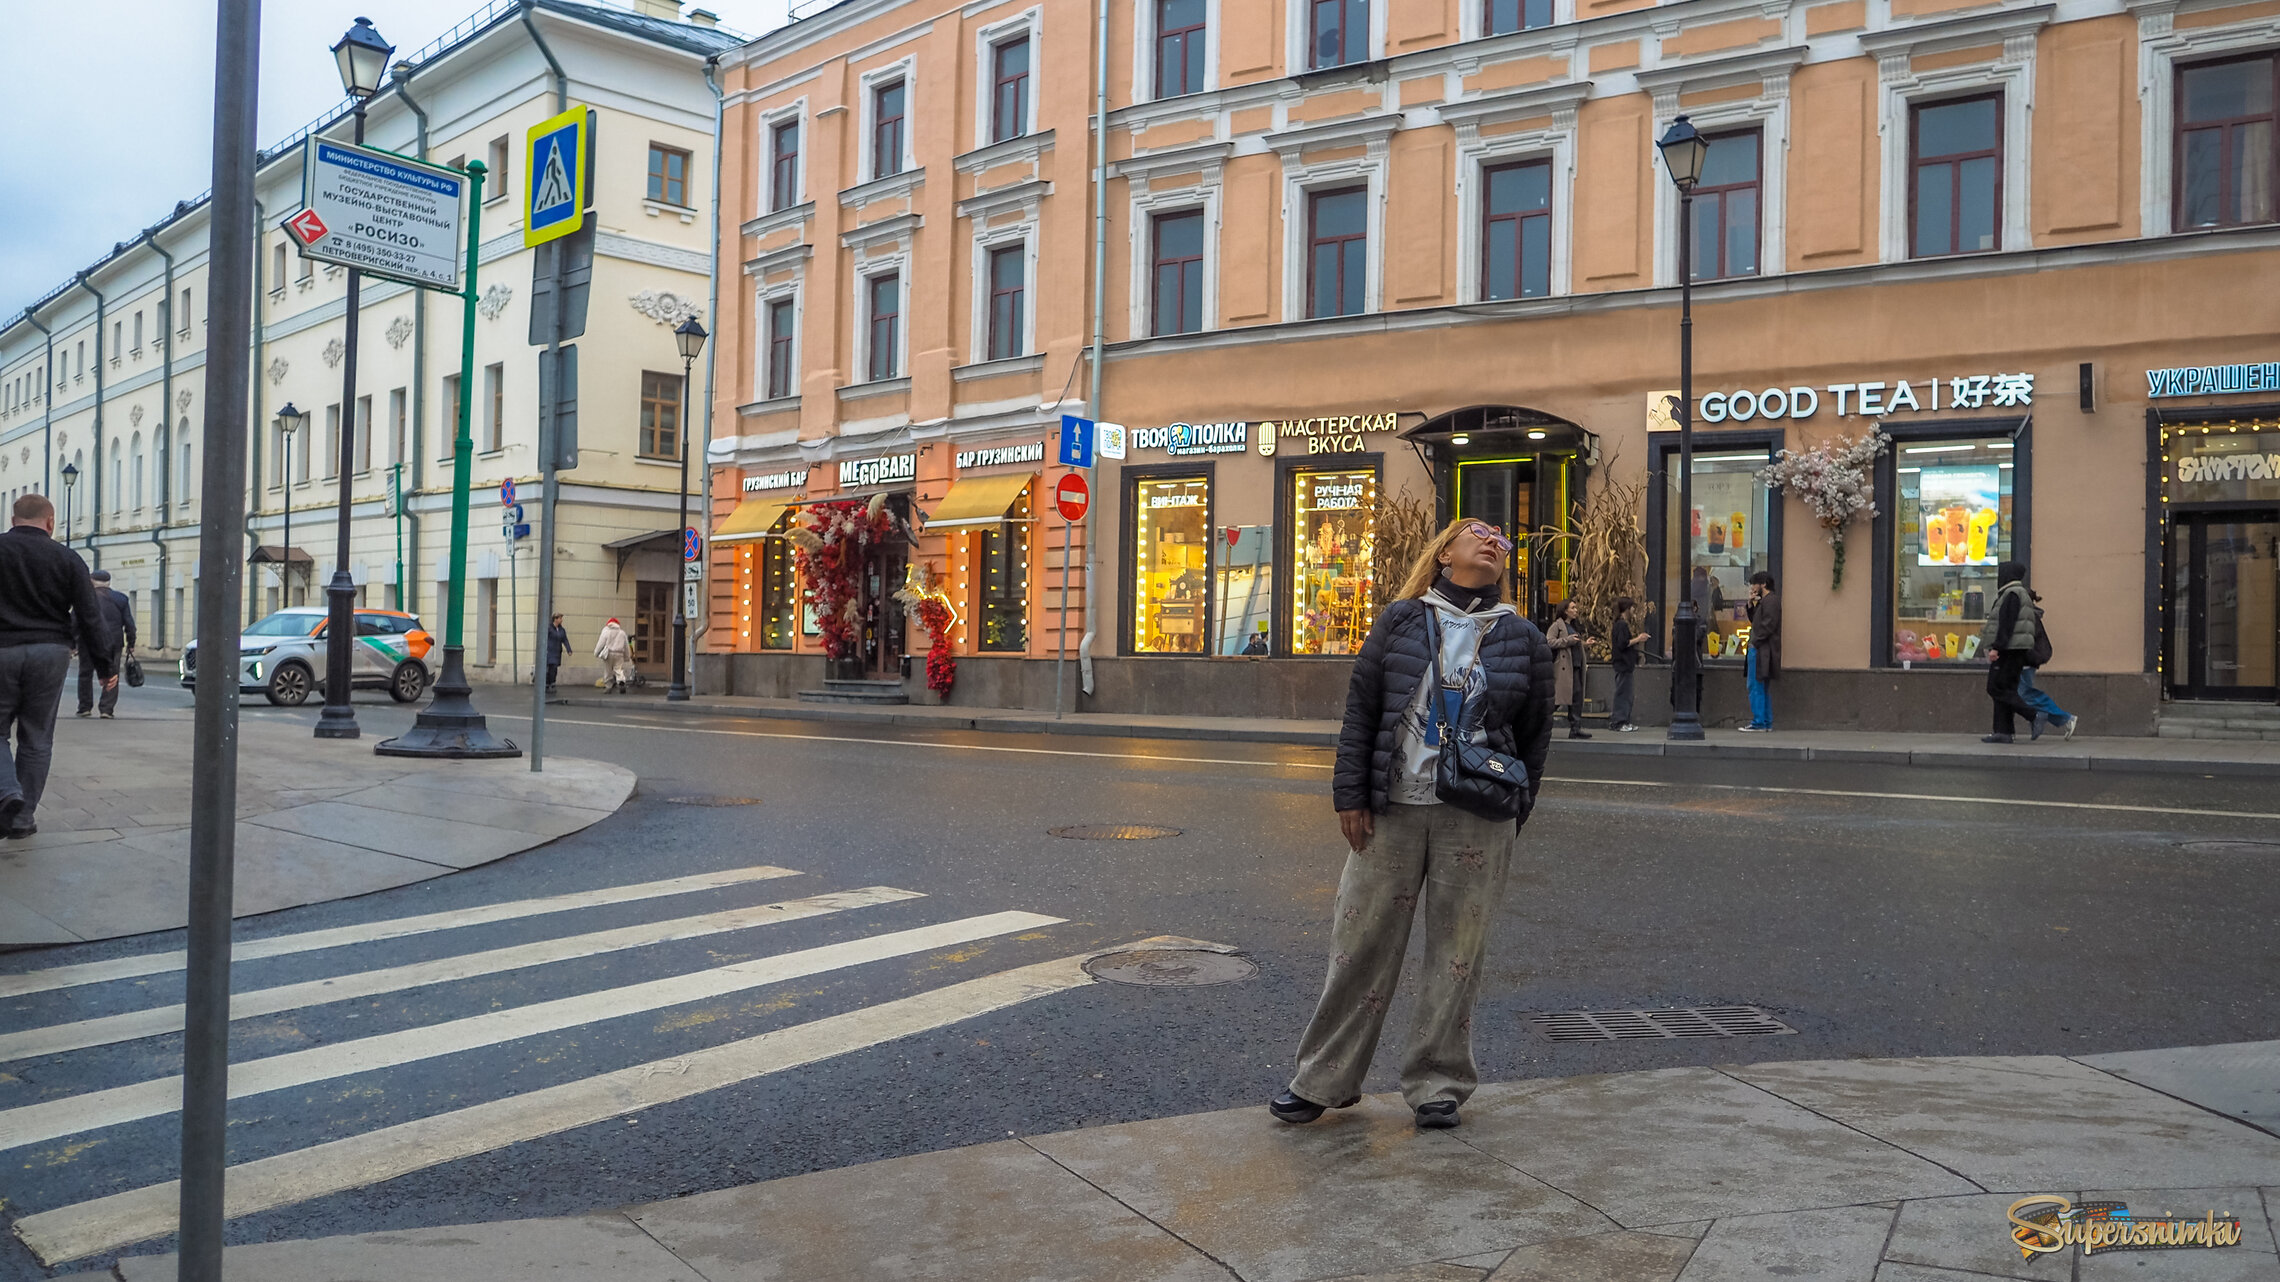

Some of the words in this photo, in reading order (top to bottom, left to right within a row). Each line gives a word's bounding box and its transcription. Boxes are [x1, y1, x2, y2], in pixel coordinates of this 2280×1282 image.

[326, 151, 396, 177] МИНИСТЕРСТВО
[397, 170, 439, 189] КУЛЬТУРЫ
[440, 183, 453, 192] РФ
[322, 191, 450, 230] МУЗЕЙНО-ВЫСТАВОЧНЫЙ
[339, 184, 437, 215] ГОСУДАРСТВЕННЫЙ
[372, 215, 404, 228] ЦЕНТР
[348, 222, 425, 248] «РОСИЗО»
[322, 246, 403, 270] ПЕТРОВЕРИГСКИЙ
[345, 240, 352, 248] 8
[353, 242, 375, 255] (495)
[376, 248, 416, 264] 350-33-27
[1700, 387, 1819, 423] GOOD
[1827, 380, 1920, 417] TEA
[1950, 372, 2035, 409] 好茶
[1130, 427, 1169, 449] ТВОЯ
[1192, 422, 1247, 445] ПОЛКА
[1280, 412, 1397, 437] МАСТЕРСКАЯ
[955, 451, 975, 468] БАР
[976, 440, 1044, 466] ГРУЗИНСКИЙ
[1308, 434, 1366, 454] ВКУСА
[742, 470, 790, 492] ГРУЗИНСКИЙ
[790, 470, 807, 487] БАР
[839, 453, 916, 486] MEGOBARI
[1151, 494, 1199, 508] ВИНТАЖ
[1314, 483, 1364, 497] РУЧНАЯ
[1316, 496, 1359, 509] РАБОТА
[687, 599, 696, 607] 50
